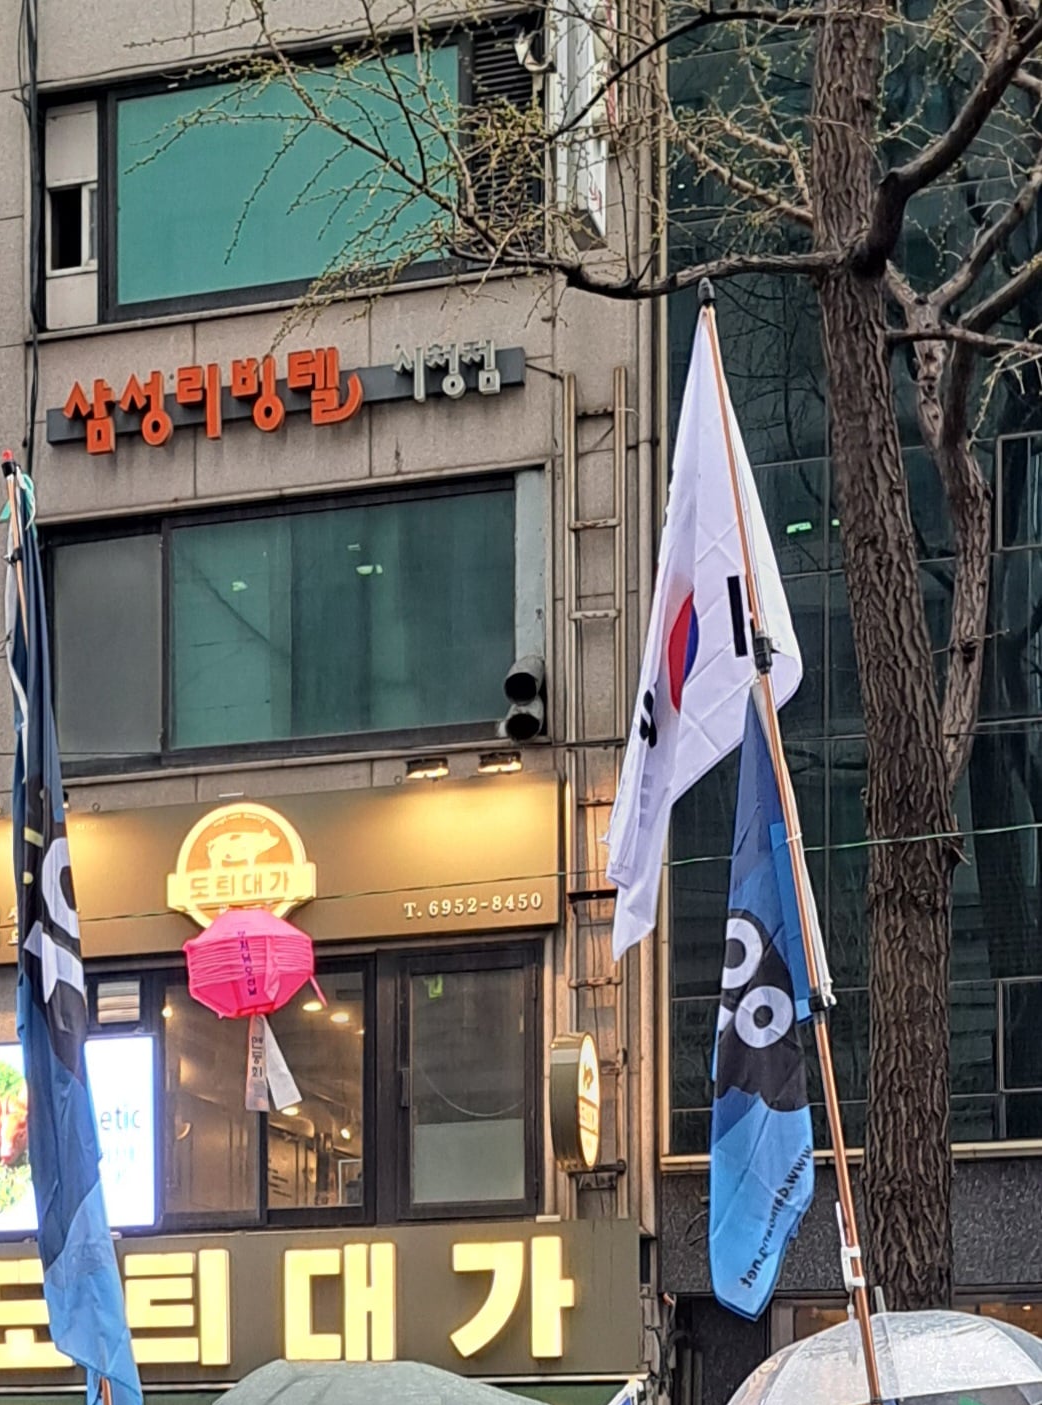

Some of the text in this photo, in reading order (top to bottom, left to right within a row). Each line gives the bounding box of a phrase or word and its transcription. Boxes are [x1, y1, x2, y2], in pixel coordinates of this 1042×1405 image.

[62, 339, 501, 455] 삼성리빙텔 시청점
[429, 892, 542, 917] 6952-8450
